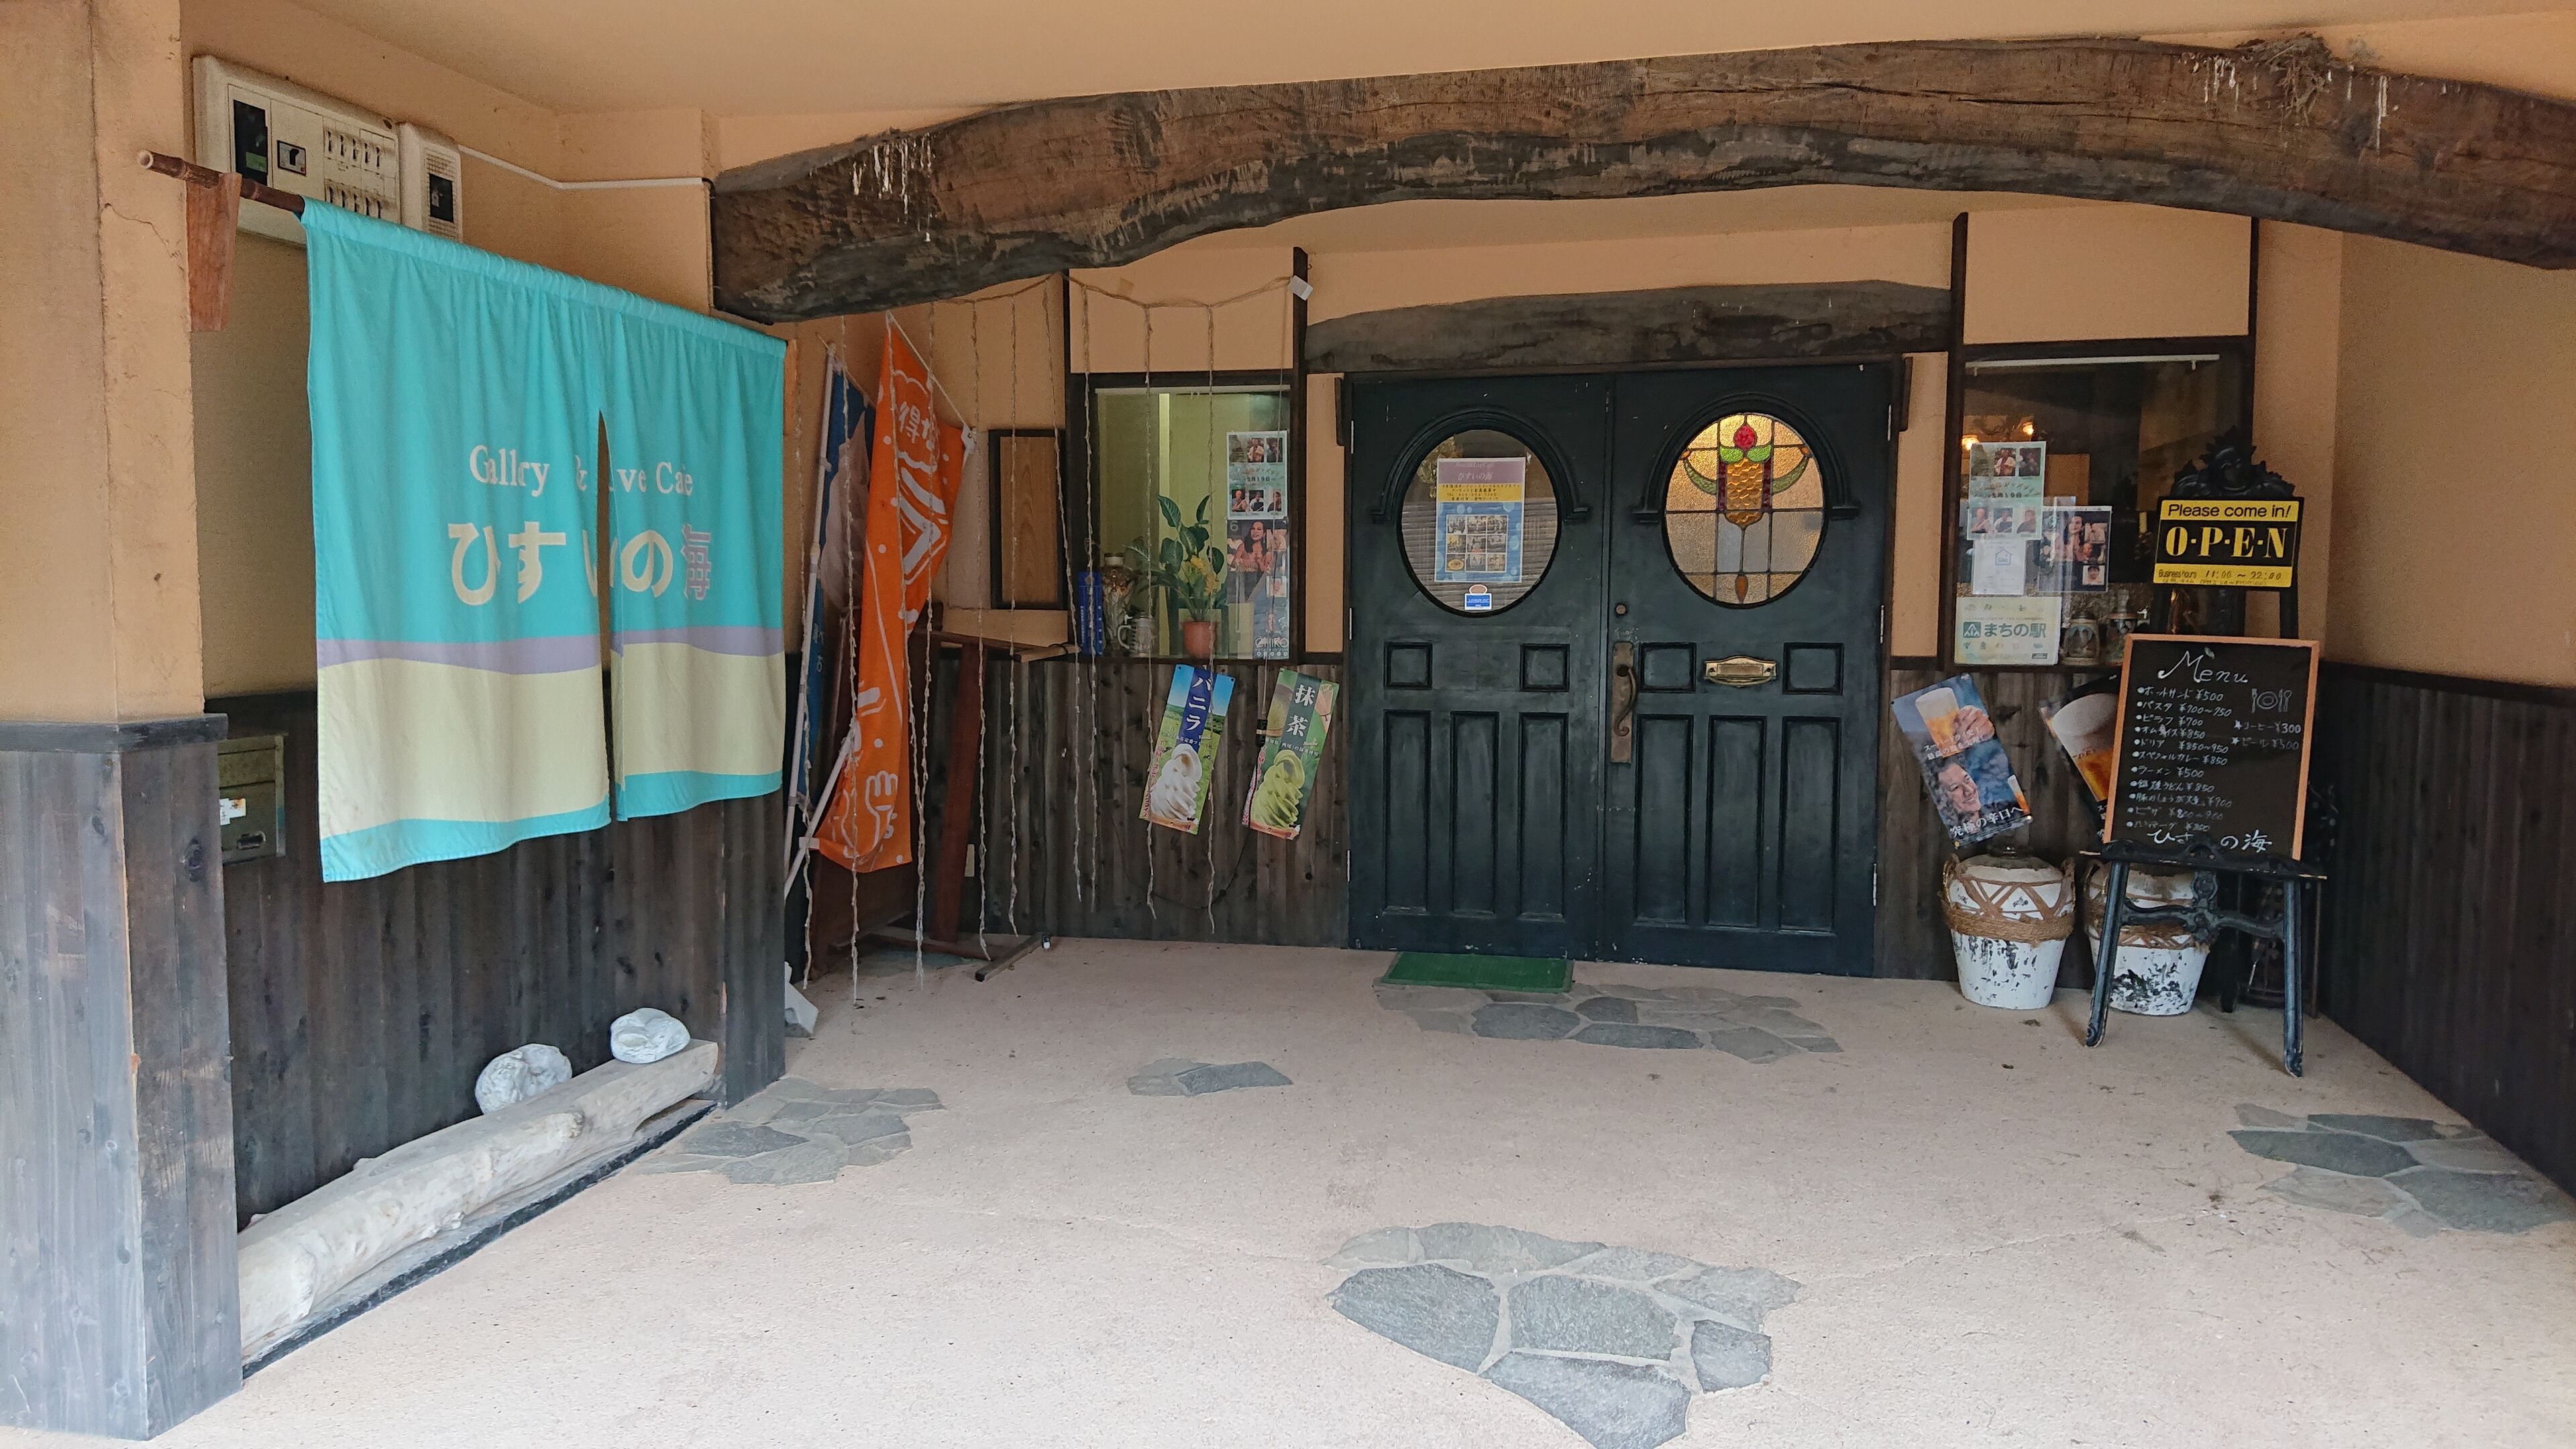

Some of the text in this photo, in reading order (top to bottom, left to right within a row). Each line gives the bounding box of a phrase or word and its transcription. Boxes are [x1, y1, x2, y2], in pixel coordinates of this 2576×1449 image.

[655, 461, 693, 496] Cae
[2168, 504, 2292, 518] Please come in!
[1984, 623, 2047, 638] まちの駅
[2157, 650, 2248, 683] Menu
[1185, 676, 1213, 731] バニラ
[1286, 684, 1316, 737] 抹茶
[1949, 806, 2025, 838] 究極の辛口へ
